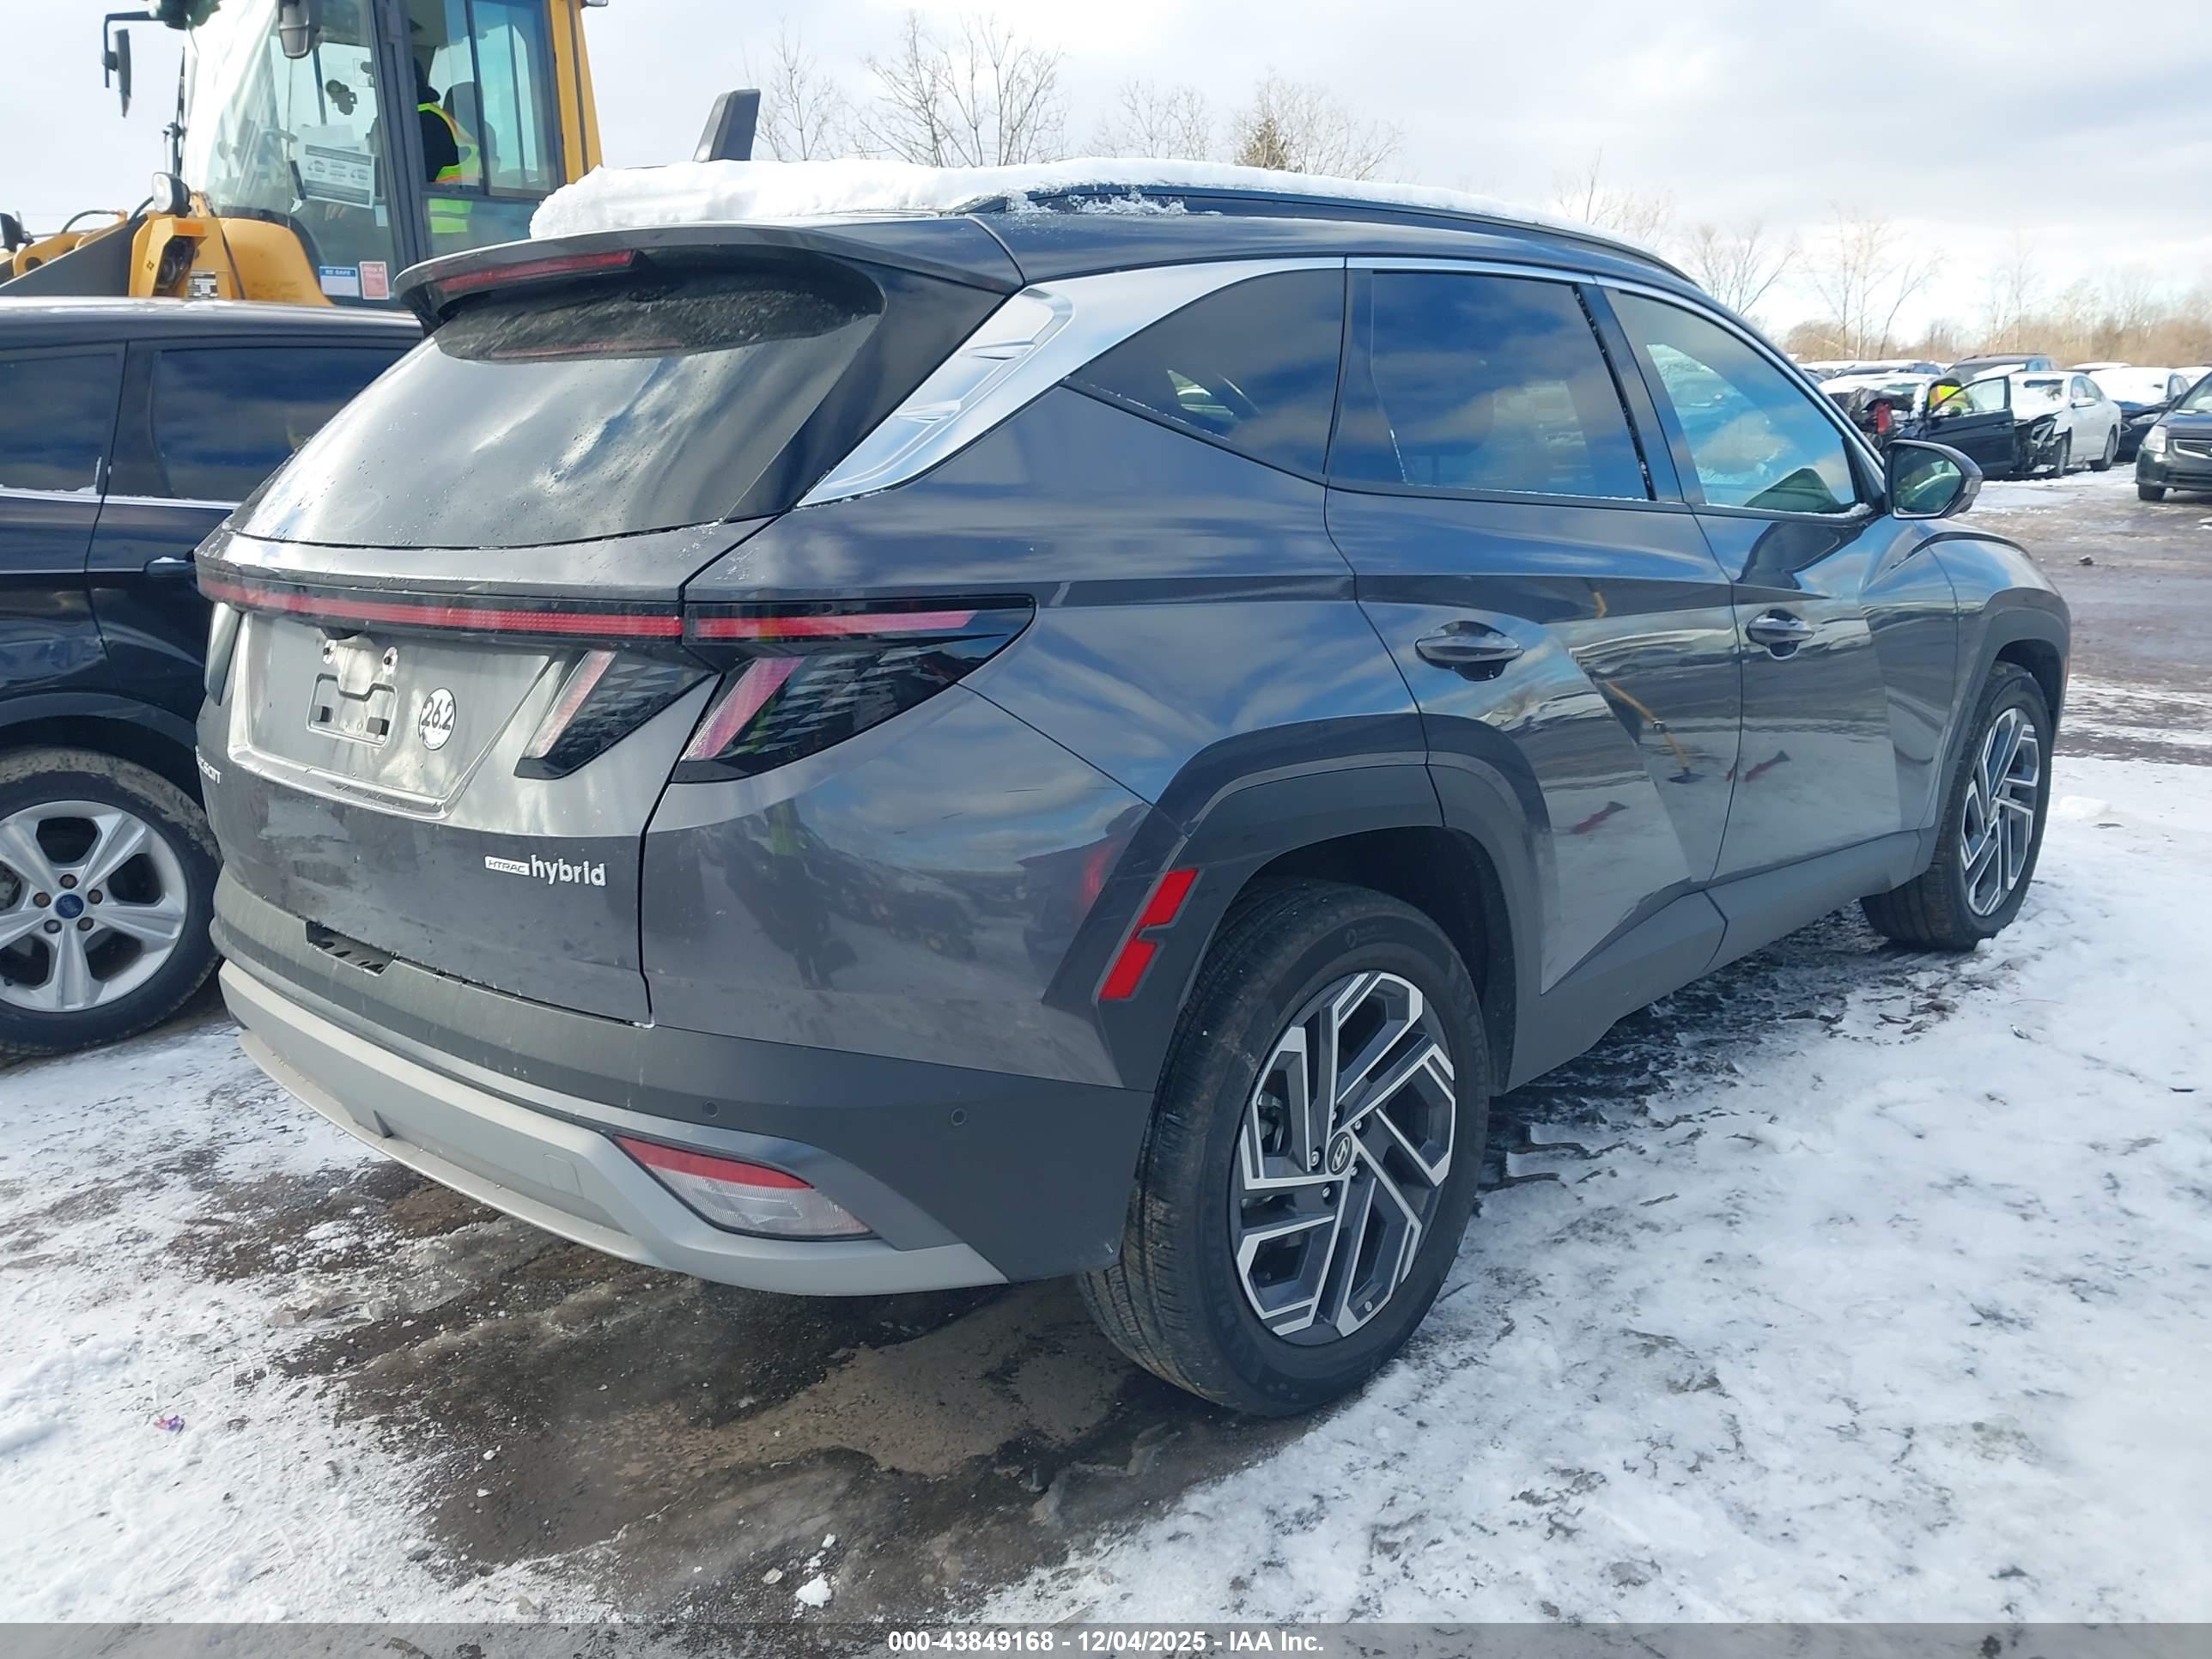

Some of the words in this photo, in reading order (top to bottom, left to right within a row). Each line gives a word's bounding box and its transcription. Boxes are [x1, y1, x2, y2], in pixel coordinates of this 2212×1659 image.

[421, 696, 454, 731] 26.2
[487, 859, 526, 874] HTRAC
[530, 854, 607, 887] hybrid
